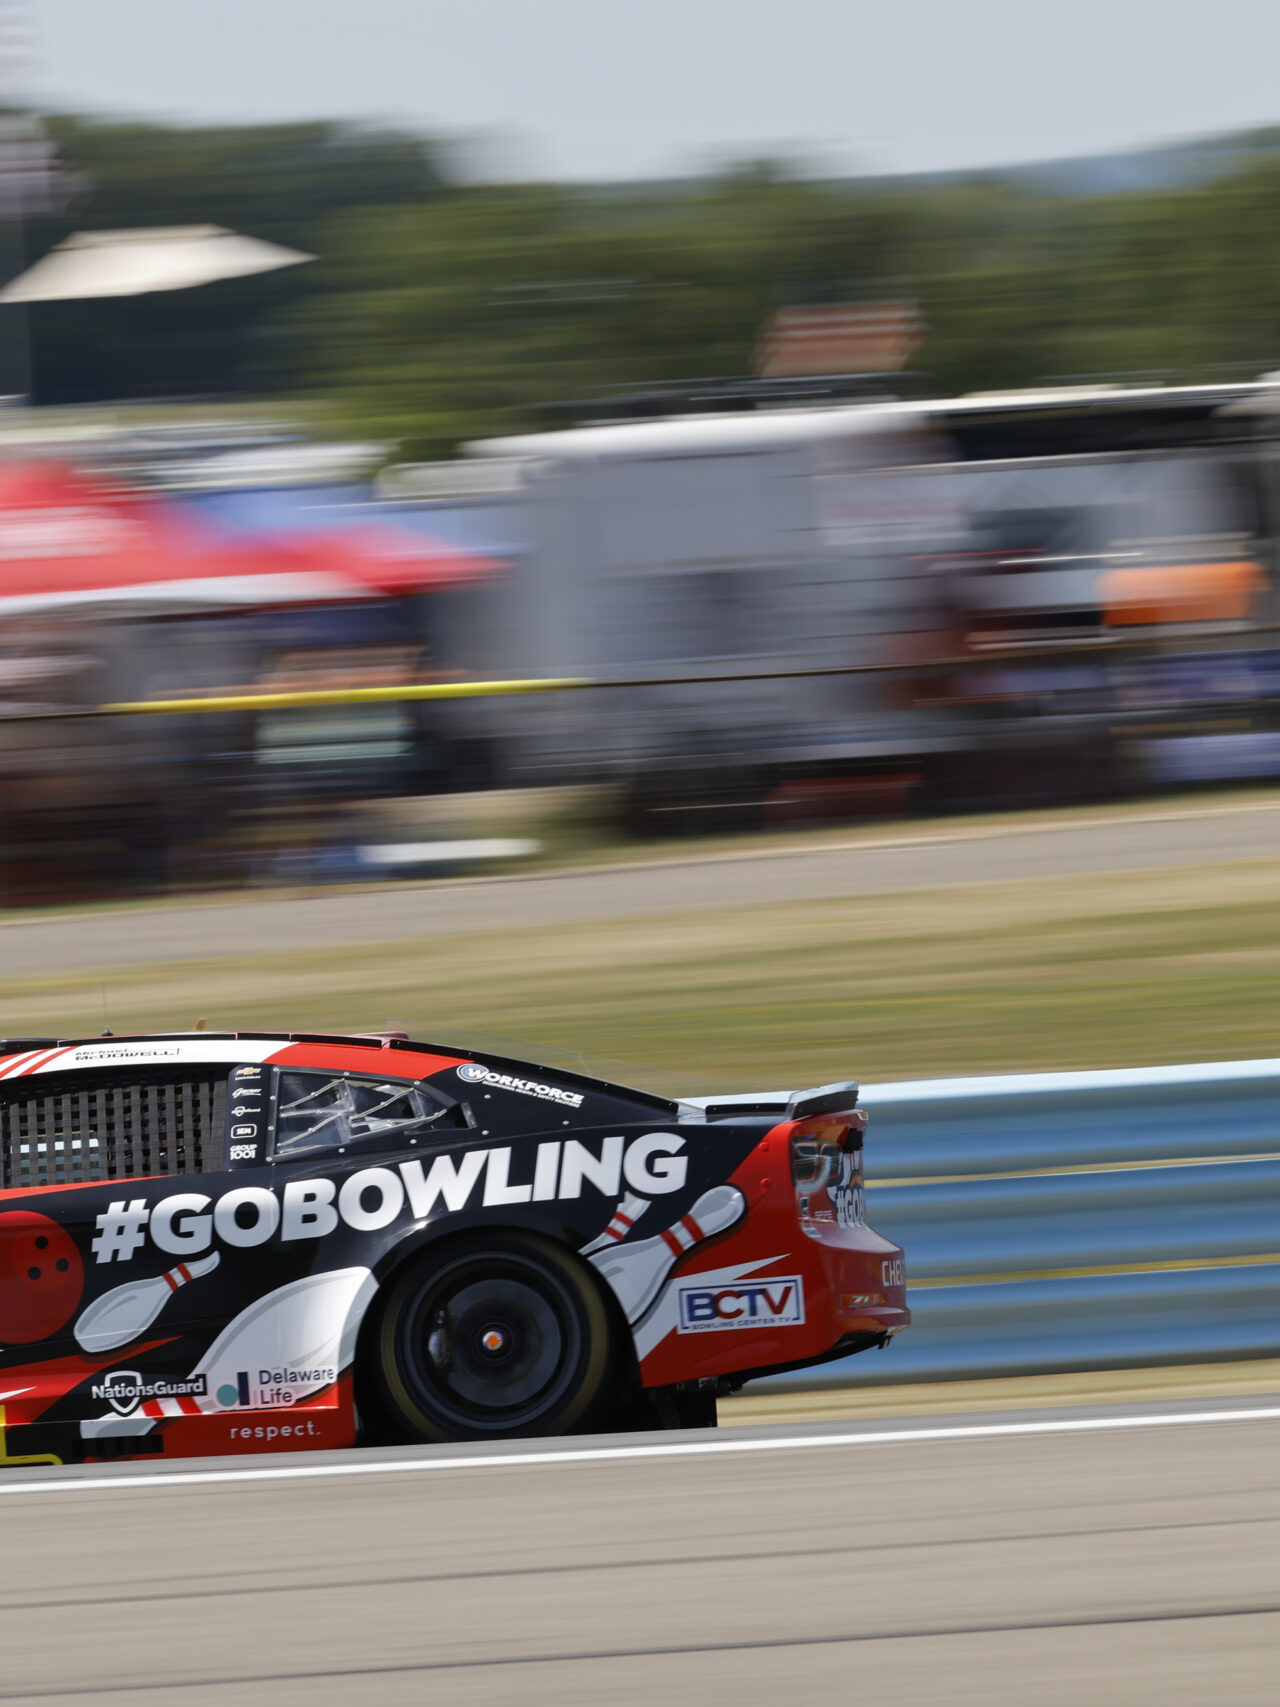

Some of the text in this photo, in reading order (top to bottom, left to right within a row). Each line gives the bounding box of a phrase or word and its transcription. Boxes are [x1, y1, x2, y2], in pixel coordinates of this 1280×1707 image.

[467, 1067, 585, 1104] WORKFORCE
[230, 1143, 258, 1152] GROUP
[91, 1132, 688, 1265] #GOBOWLING
[686, 1285, 793, 1322] BCTV
[691, 1321, 734, 1330] BOWLING
[737, 1317, 776, 1327] CENTER
[258, 1368, 335, 1385] Delaware
[92, 1378, 205, 1399] NationsGuard
[260, 1389, 293, 1405] Life
[230, 1420, 322, 1441] respect.
